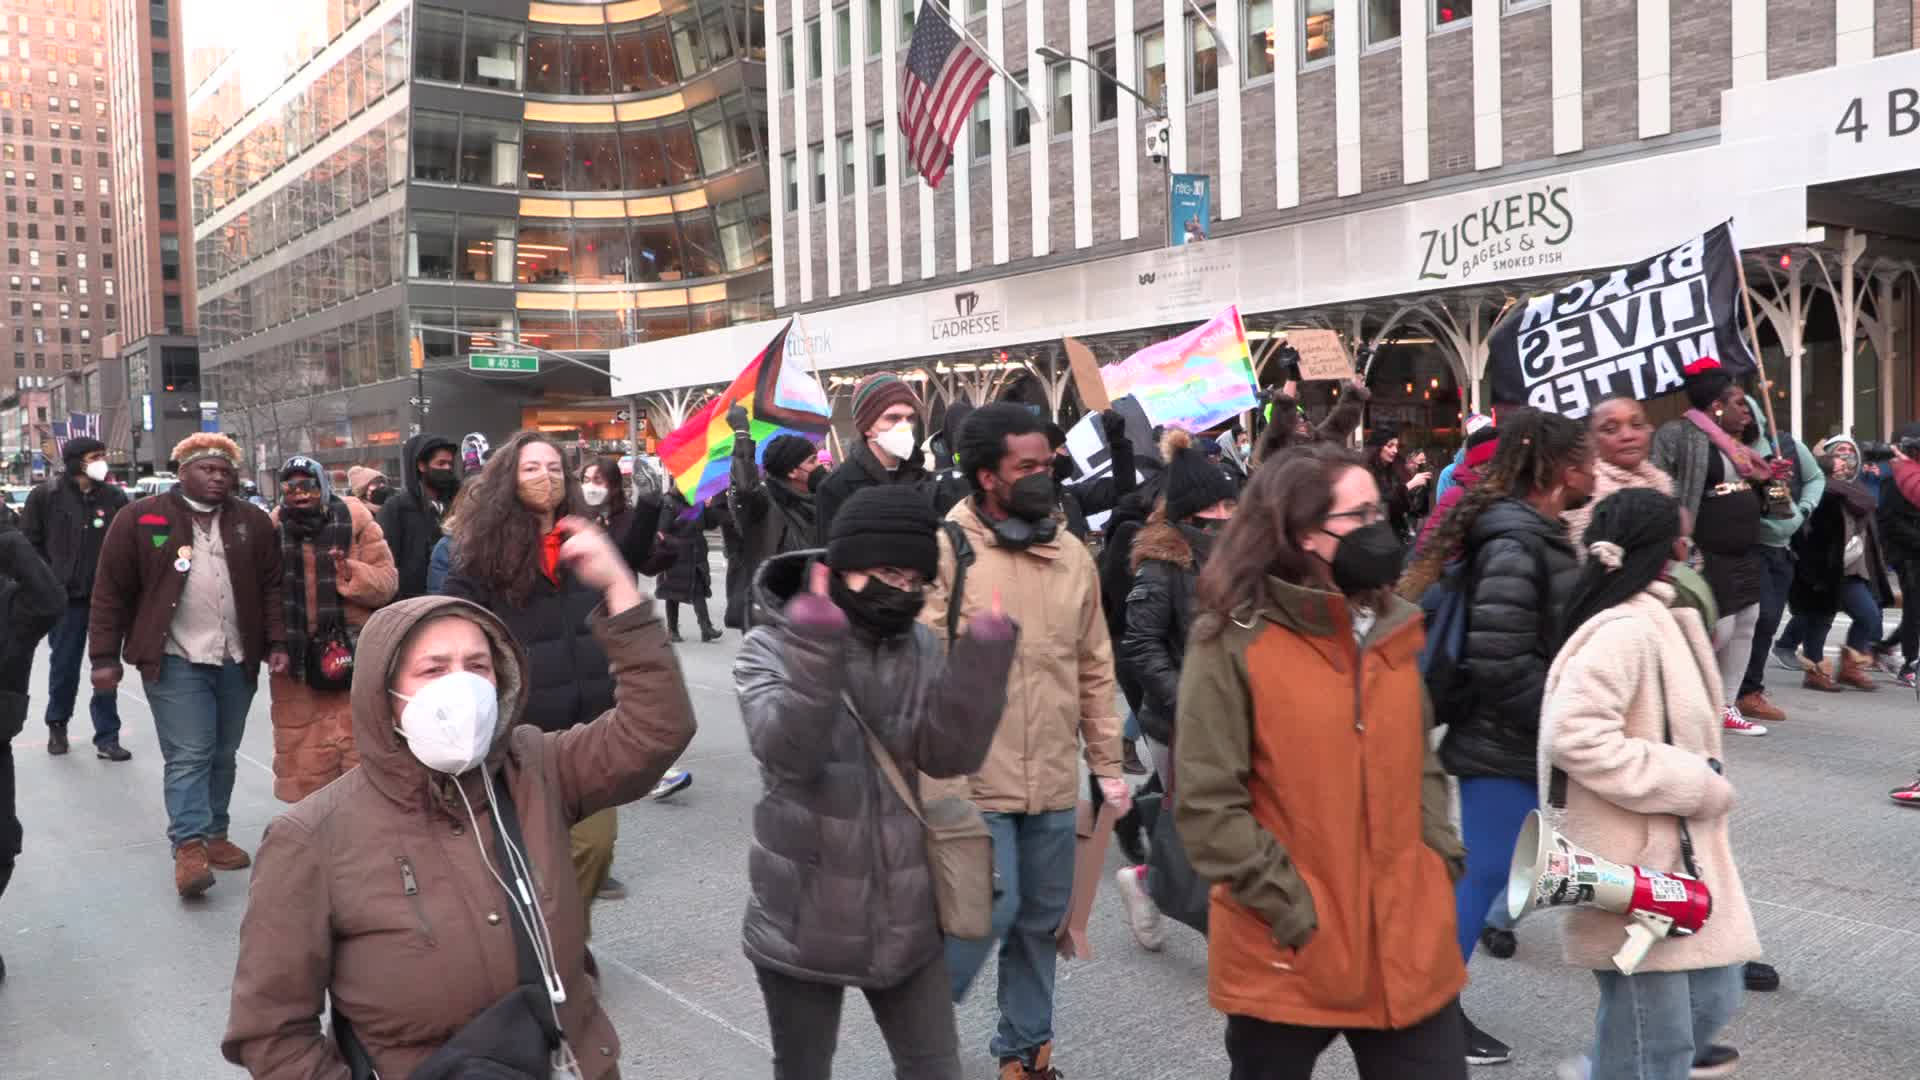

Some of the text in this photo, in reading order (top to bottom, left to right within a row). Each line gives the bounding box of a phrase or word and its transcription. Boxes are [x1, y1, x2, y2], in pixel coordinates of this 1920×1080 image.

[1834, 87, 1920, 143] 4 B
[1418, 185, 1573, 280] ZUCKER'S
[1462, 233, 1535, 279] BAGELS &
[1492, 252, 1562, 271] SMOKED FISH
[932, 315, 1000, 340] L'ADRESSE
[497, 358, 510, 368] 40
